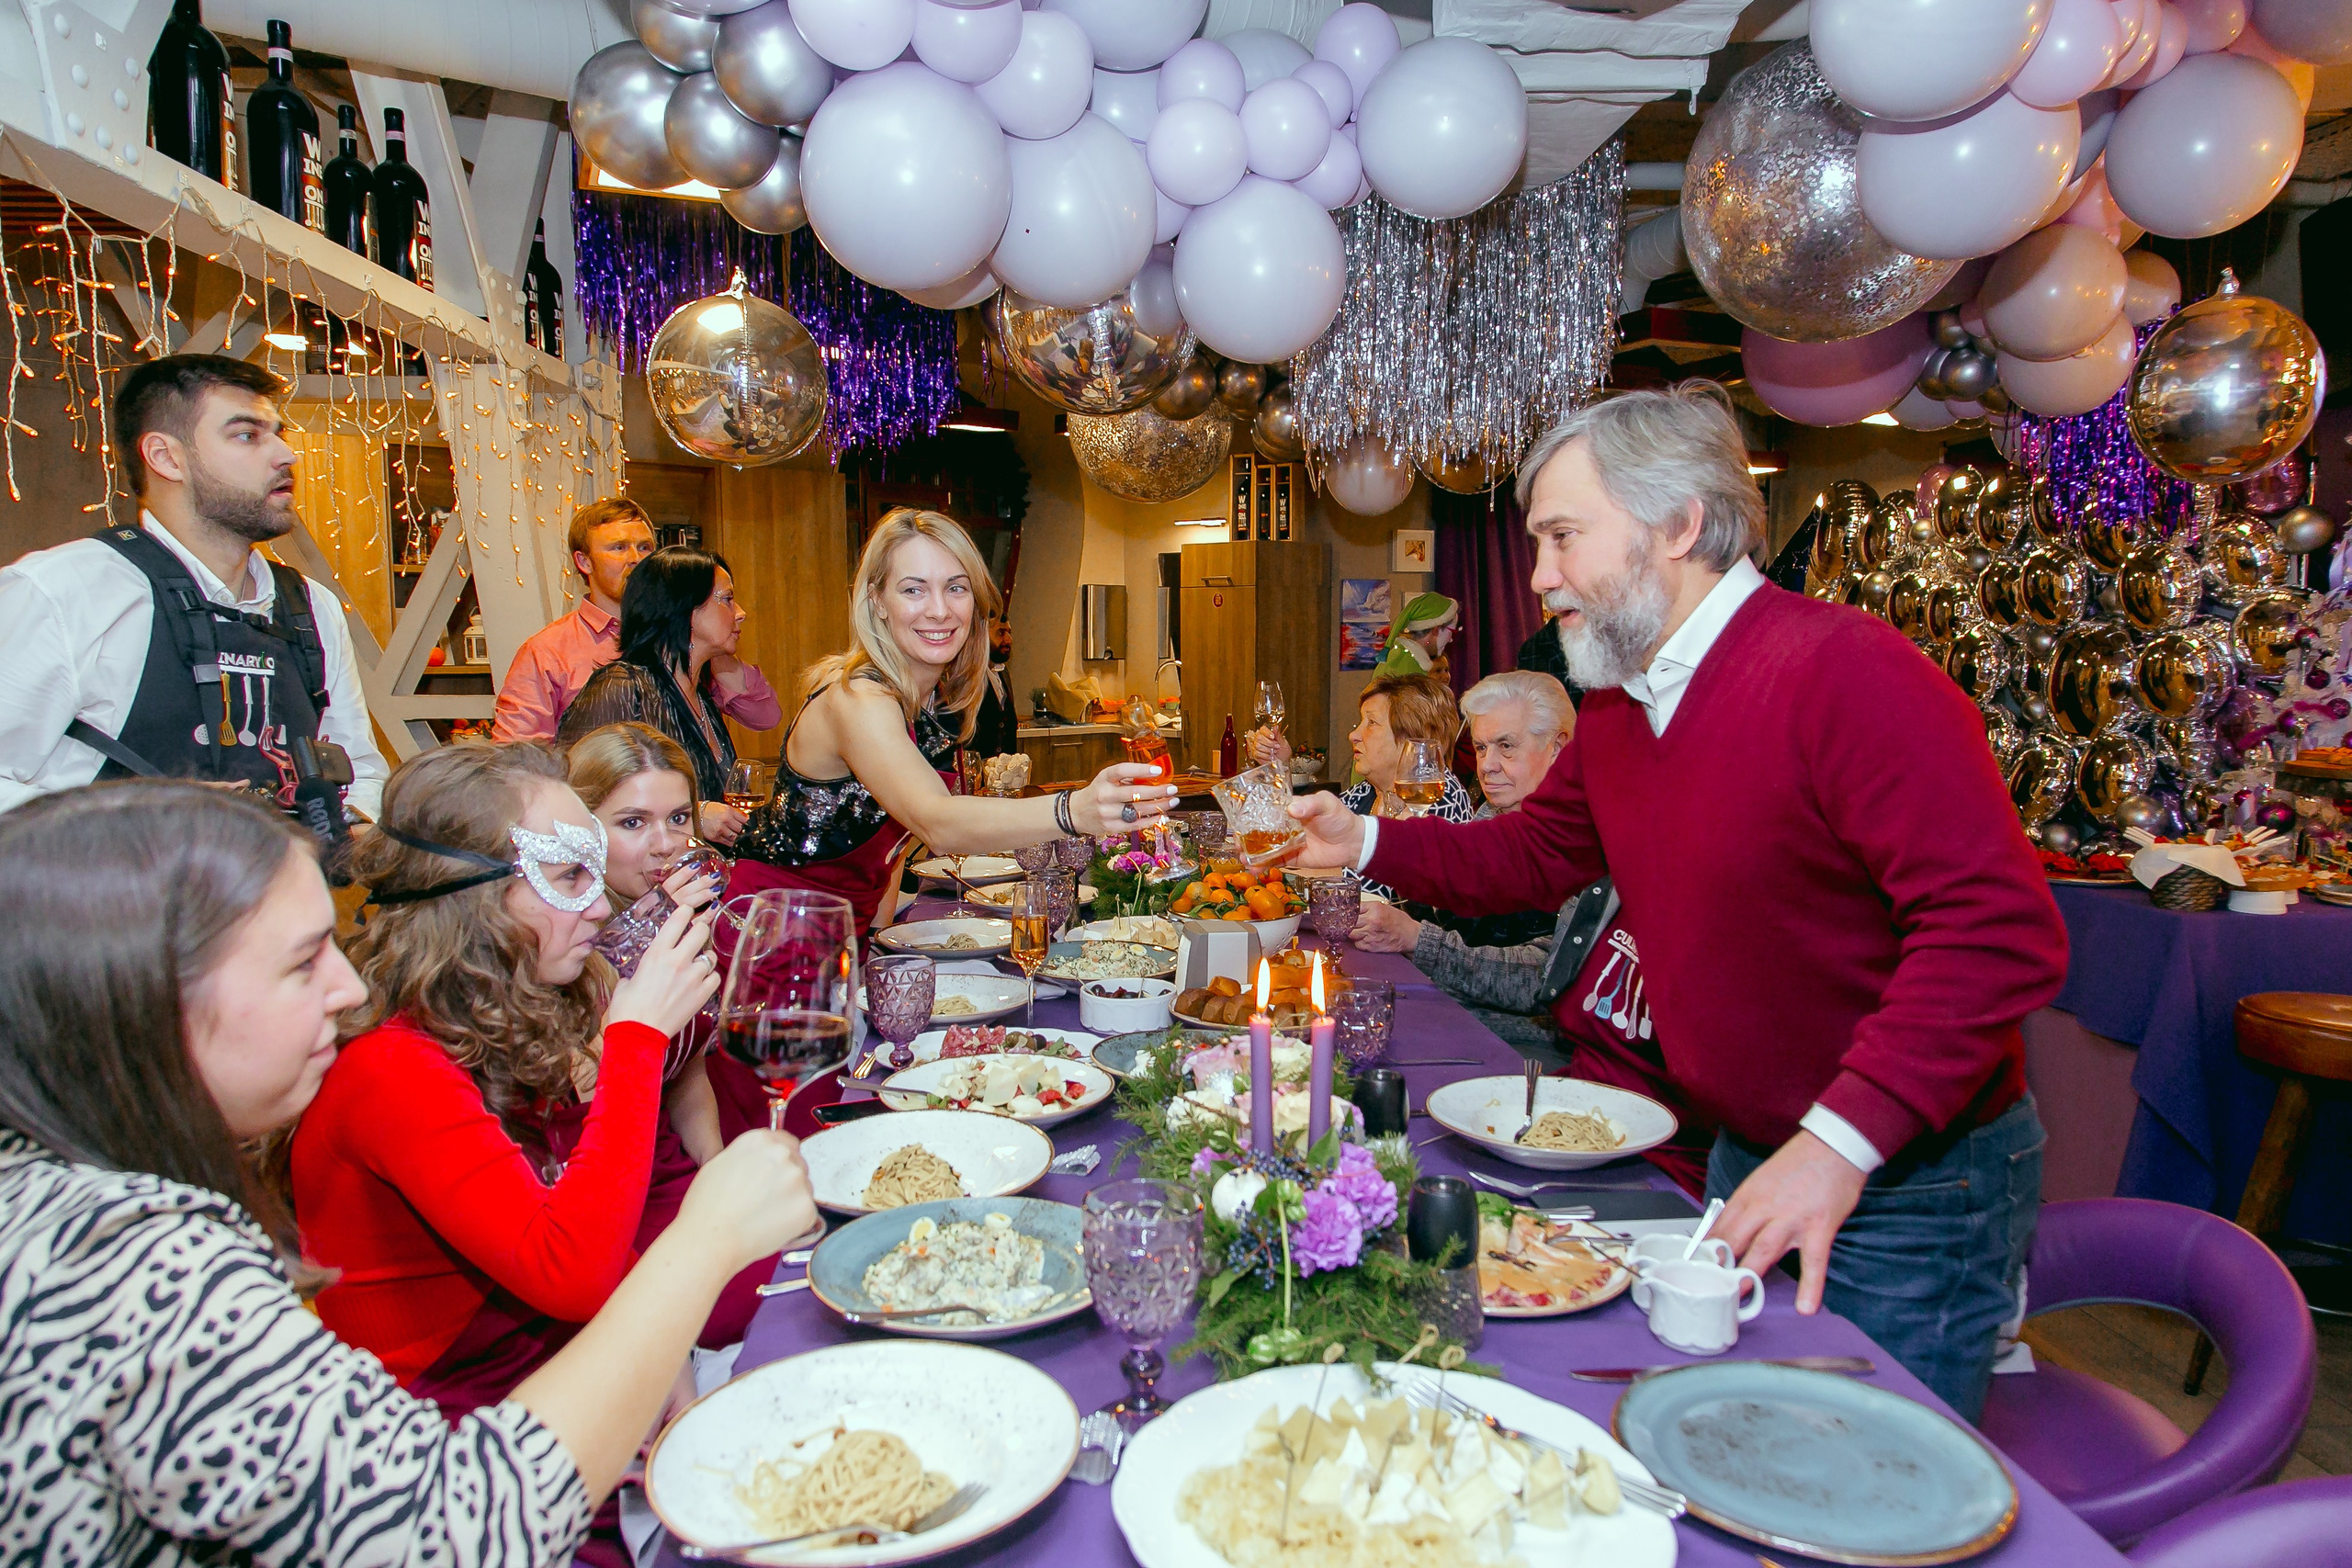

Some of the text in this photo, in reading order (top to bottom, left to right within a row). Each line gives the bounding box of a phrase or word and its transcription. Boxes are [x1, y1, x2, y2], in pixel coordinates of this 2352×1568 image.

[302, 132, 321, 162] W
[304, 185, 323, 205] ON
[418, 221, 431, 237] IN
